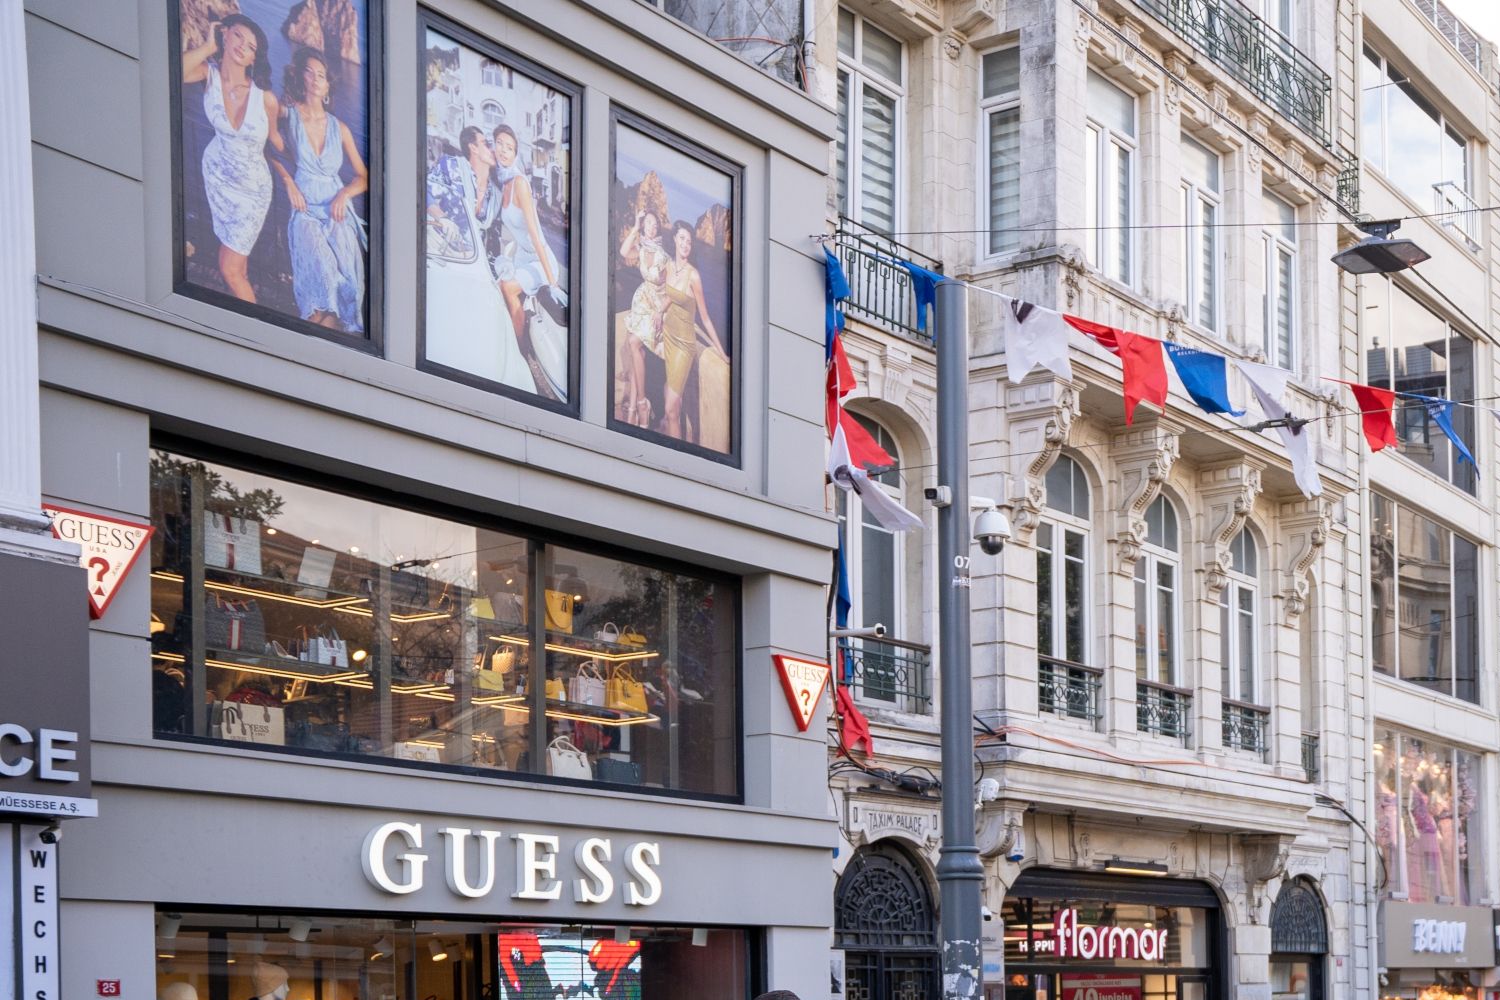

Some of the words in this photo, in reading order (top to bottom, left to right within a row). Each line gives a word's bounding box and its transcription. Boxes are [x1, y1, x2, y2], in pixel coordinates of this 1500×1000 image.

[60, 518, 135, 551] GUESS
[89, 545, 107, 554] USA
[954, 555, 970, 569] 07
[788, 664, 824, 684] GUESS
[0, 723, 79, 781] CE
[59, 802, 80, 813] A.Ş.
[869, 812, 894, 831] TAXIM
[896, 815, 922, 835] PALACE
[361, 821, 662, 906] GUESS
[1057, 909, 1168, 960] flormar
[102, 982, 116, 994] 25
